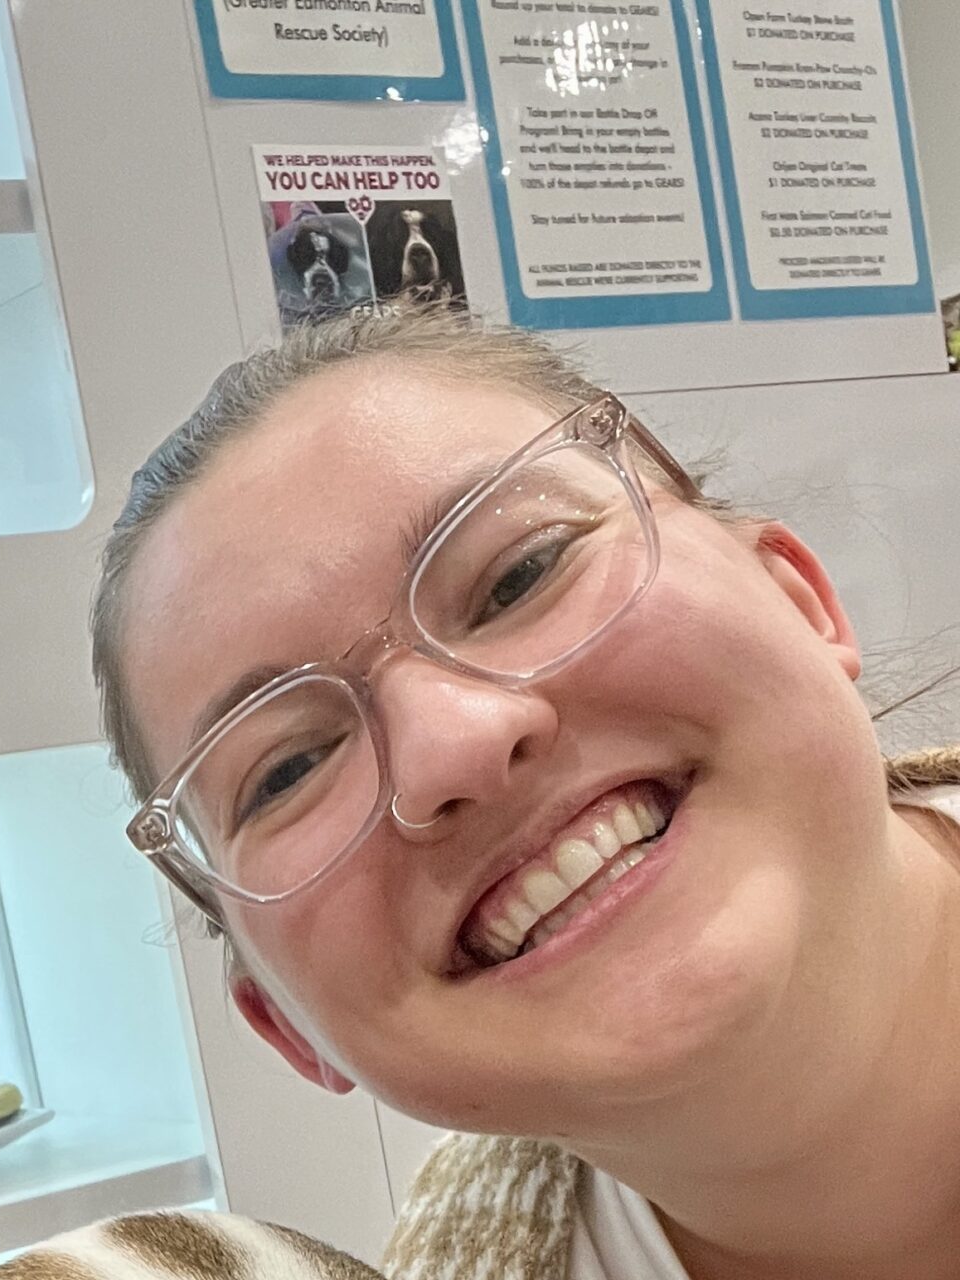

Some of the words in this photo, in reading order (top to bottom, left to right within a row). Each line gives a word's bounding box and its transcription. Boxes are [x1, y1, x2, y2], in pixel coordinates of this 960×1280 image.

[375, 0, 426, 15] Animal
[742, 10, 765, 22] Open
[274, 23, 328, 41] Rescue
[333, 23, 389, 48] Society)
[758, 28, 798, 39] DONATED
[799, 30, 814, 40] ON
[815, 30, 855, 42] PURCHASE
[765, 78, 806, 89] DONATED
[807, 79, 822, 89] ON
[822, 79, 863, 91] PURCHASE
[526, 106, 547, 118] Take
[772, 128, 813, 138] DONATED
[814, 128, 828, 138] ON
[829, 128, 869, 139] PURCHASE
[263, 155, 283, 166] WE
[286, 155, 329, 166] HELPED
[331, 155, 362, 166] MAKE
[363, 155, 389, 166] THIS
[265, 171, 307, 190] YOU
[311, 171, 350, 190] CAN
[354, 171, 399, 190] HELP
[401, 171, 440, 190] TOO
[780, 177, 820, 187] DONATED
[821, 177, 835, 187] ON
[836, 177, 877, 187] PURCHASE
[793, 226, 833, 237] DONATED
[833, 226, 848, 236] ON
